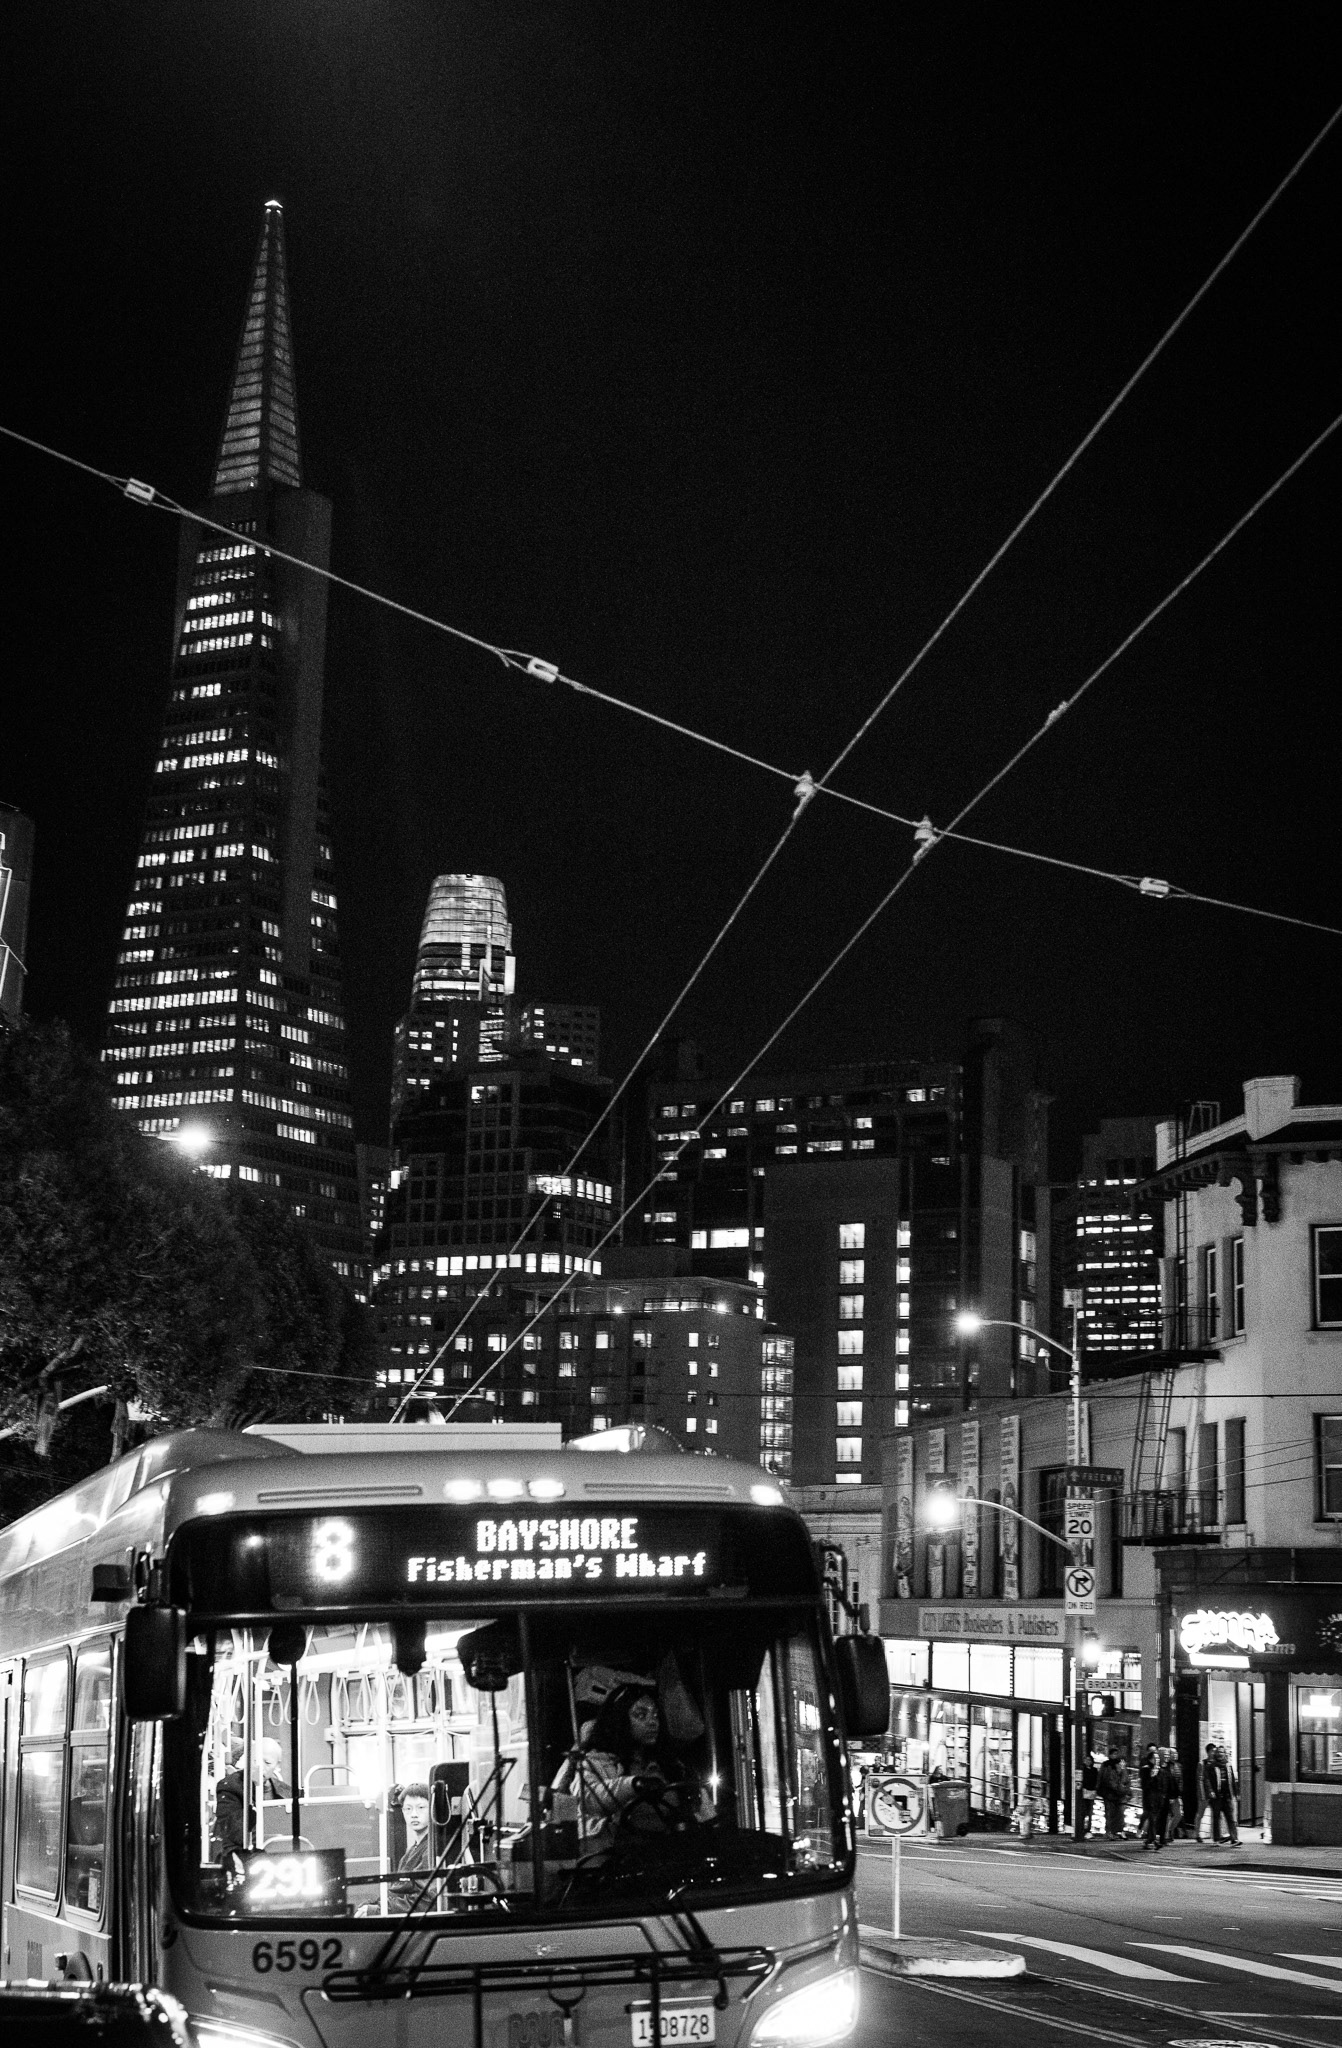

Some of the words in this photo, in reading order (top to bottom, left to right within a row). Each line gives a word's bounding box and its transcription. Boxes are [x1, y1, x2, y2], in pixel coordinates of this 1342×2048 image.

[1066, 1502, 1094, 1510] SPEED
[1069, 1510, 1090, 1518] LIMIT
[476, 1518, 638, 1552] BAYSHORE
[1068, 1520, 1092, 1534] 20
[314, 1520, 354, 1581] 8
[407, 1554, 602, 1582] Fisherman's
[615, 1552, 706, 1578] Wharf
[1067, 1602, 1078, 1610] ON
[1079, 1601, 1094, 1610] RED
[1087, 1681, 1140, 1690] BROADWAY
[248, 1856, 323, 1899] 291
[252, 1938, 343, 1974] 6592
